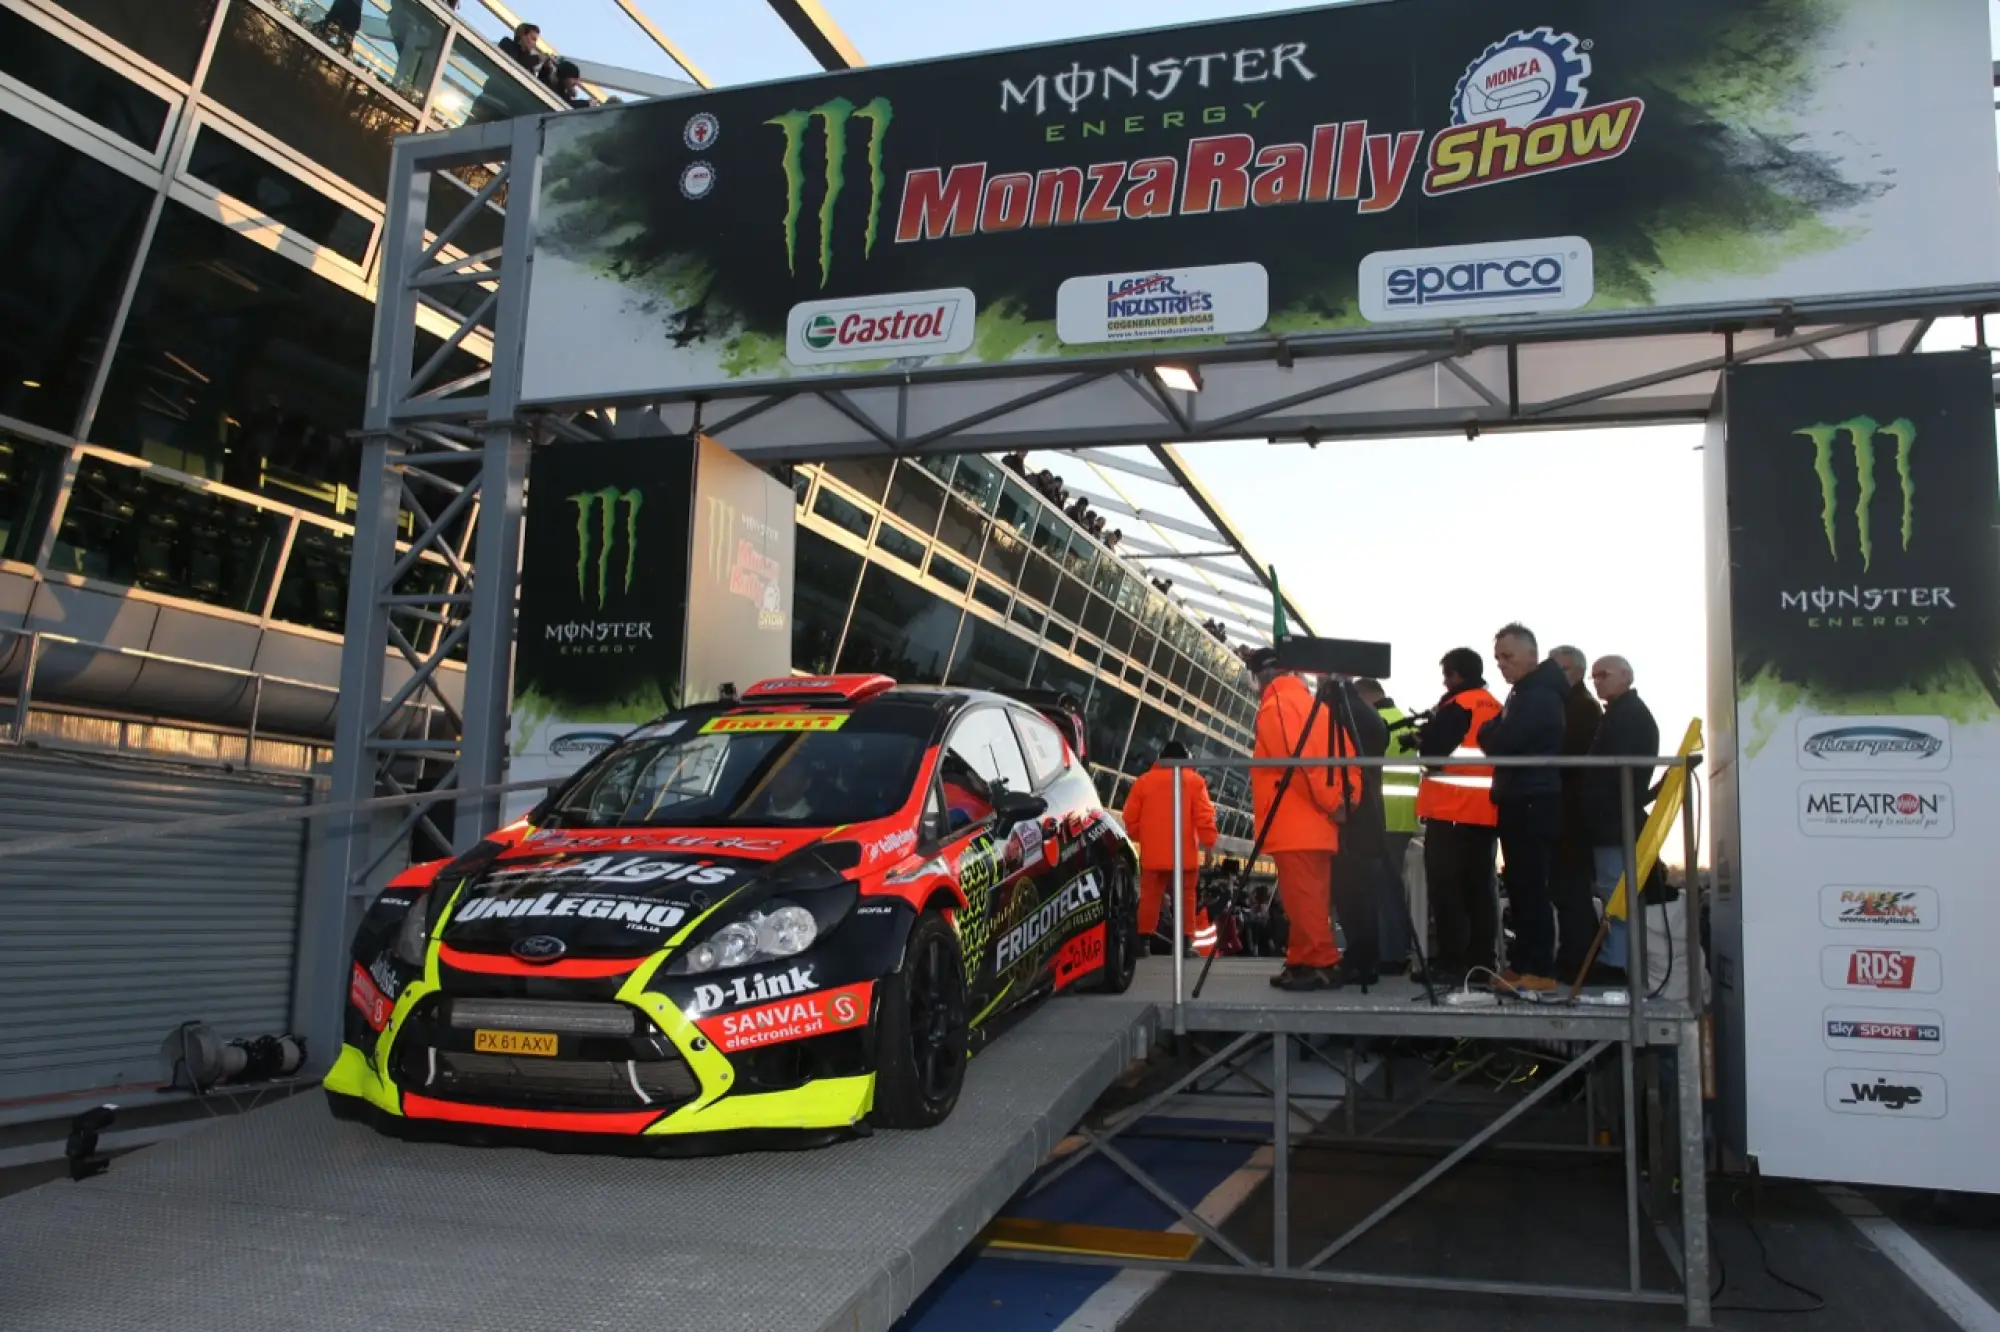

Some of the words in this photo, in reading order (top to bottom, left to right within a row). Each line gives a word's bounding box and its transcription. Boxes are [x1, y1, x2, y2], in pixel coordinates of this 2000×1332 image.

[1000, 42, 1317, 114] MONSTER
[1485, 58, 1541, 90] MONZA
[1045, 101, 1267, 142] ENERGY
[1431, 107, 1633, 188] Show
[1387, 256, 1561, 304] sparco
[838, 306, 945, 345] Castrol
[1780, 584, 1956, 613] MONSTER
[545, 620, 654, 643] MONSTER
[1808, 616, 1931, 628] ENERGY
[1807, 793, 1938, 815] METATRON
[626, 923, 660, 933] ITALIA
[997, 873, 1101, 973] FRIGOTECH
[1856, 952, 1904, 980] RDS
[694, 966, 819, 1012] D-Link
[723, 1000, 823, 1036] SANVAL
[1830, 1022, 1854, 1036] sky
[1860, 1024, 1913, 1037] SPORT
[1918, 1028, 1937, 1038] HD
[477, 1033, 497, 1048] PX
[501, 1034, 516, 1049] 61
[521, 1036, 553, 1051] AXV
[726, 1024, 802, 1049] electronic
[805, 1019, 823, 1033] srl
